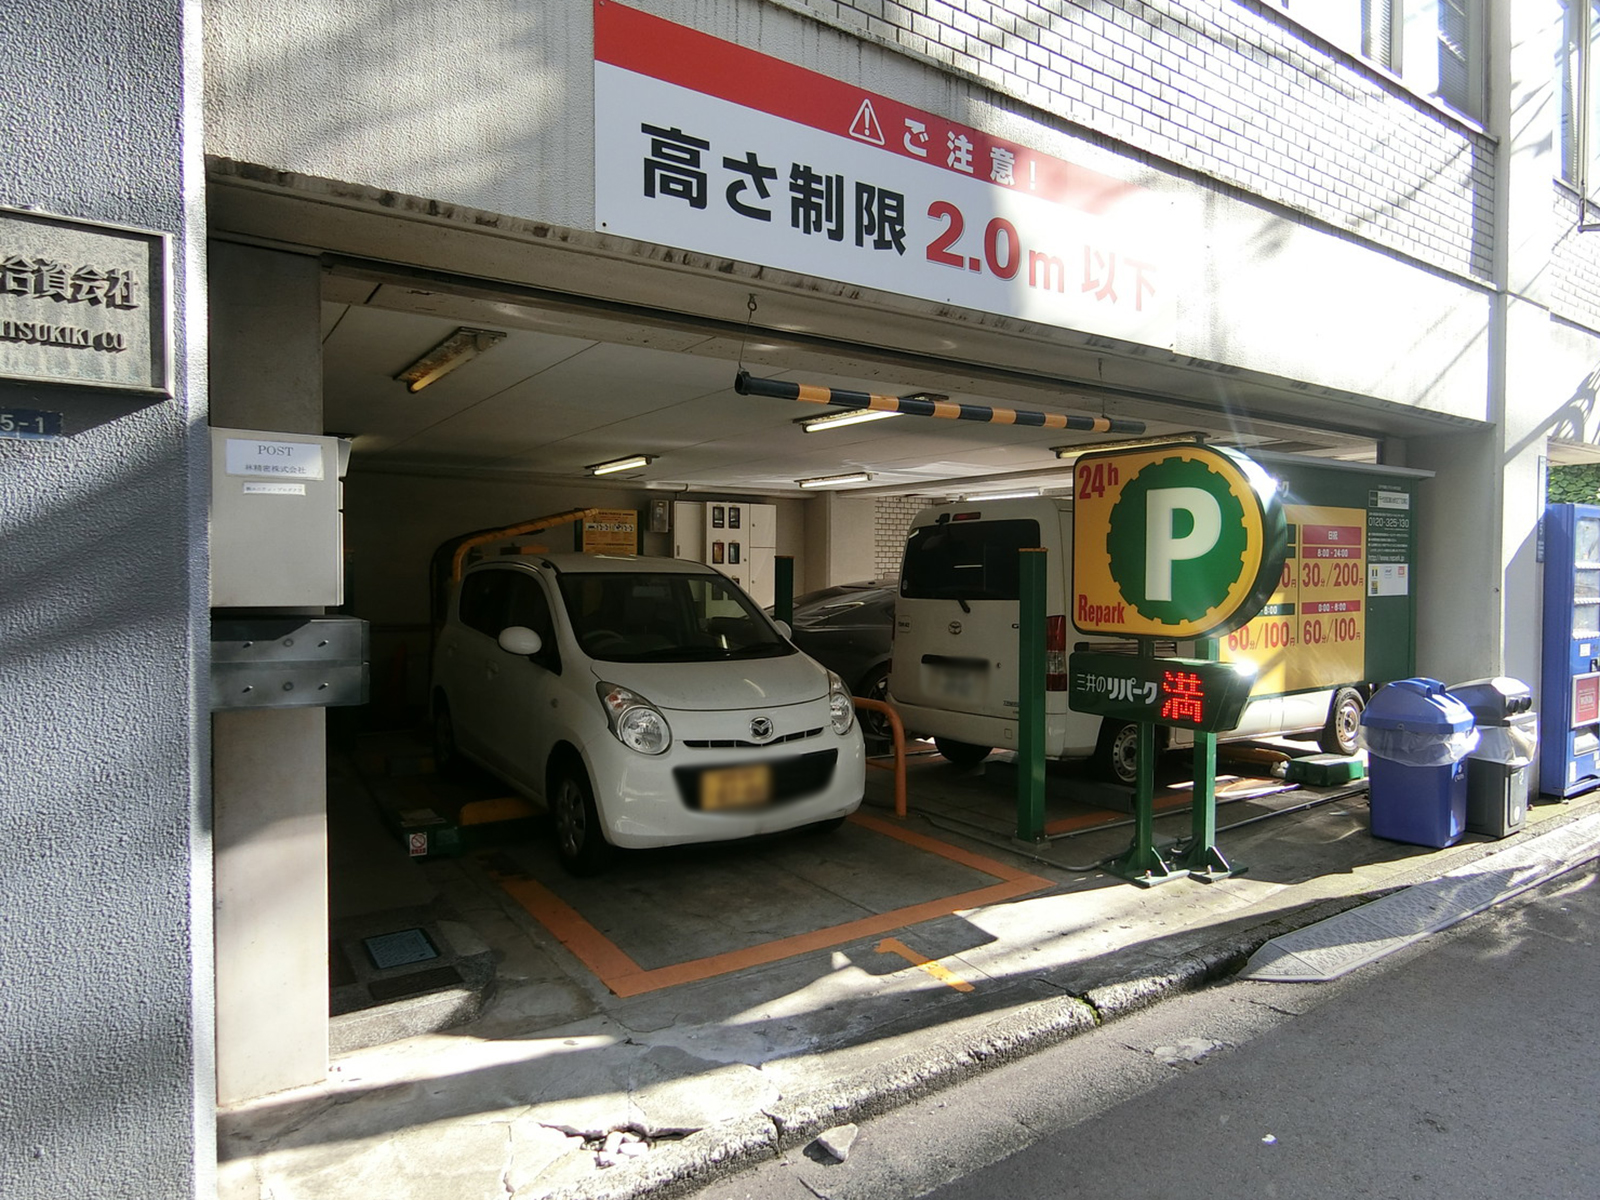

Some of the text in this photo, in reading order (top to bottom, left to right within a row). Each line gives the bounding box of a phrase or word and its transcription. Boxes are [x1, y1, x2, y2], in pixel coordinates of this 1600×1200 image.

[640, 122, 907, 257] 高さ制限
[1081, 244, 1158, 312] 以下
[257, 445, 294, 457] POST
[1078, 463, 1120, 500] 24h
[1145, 487, 1222, 602] P
[1078, 594, 1126, 626] Repark
[1076, 672, 1158, 705] 三井のリパーク
[1160, 671, 1204, 723] 満
